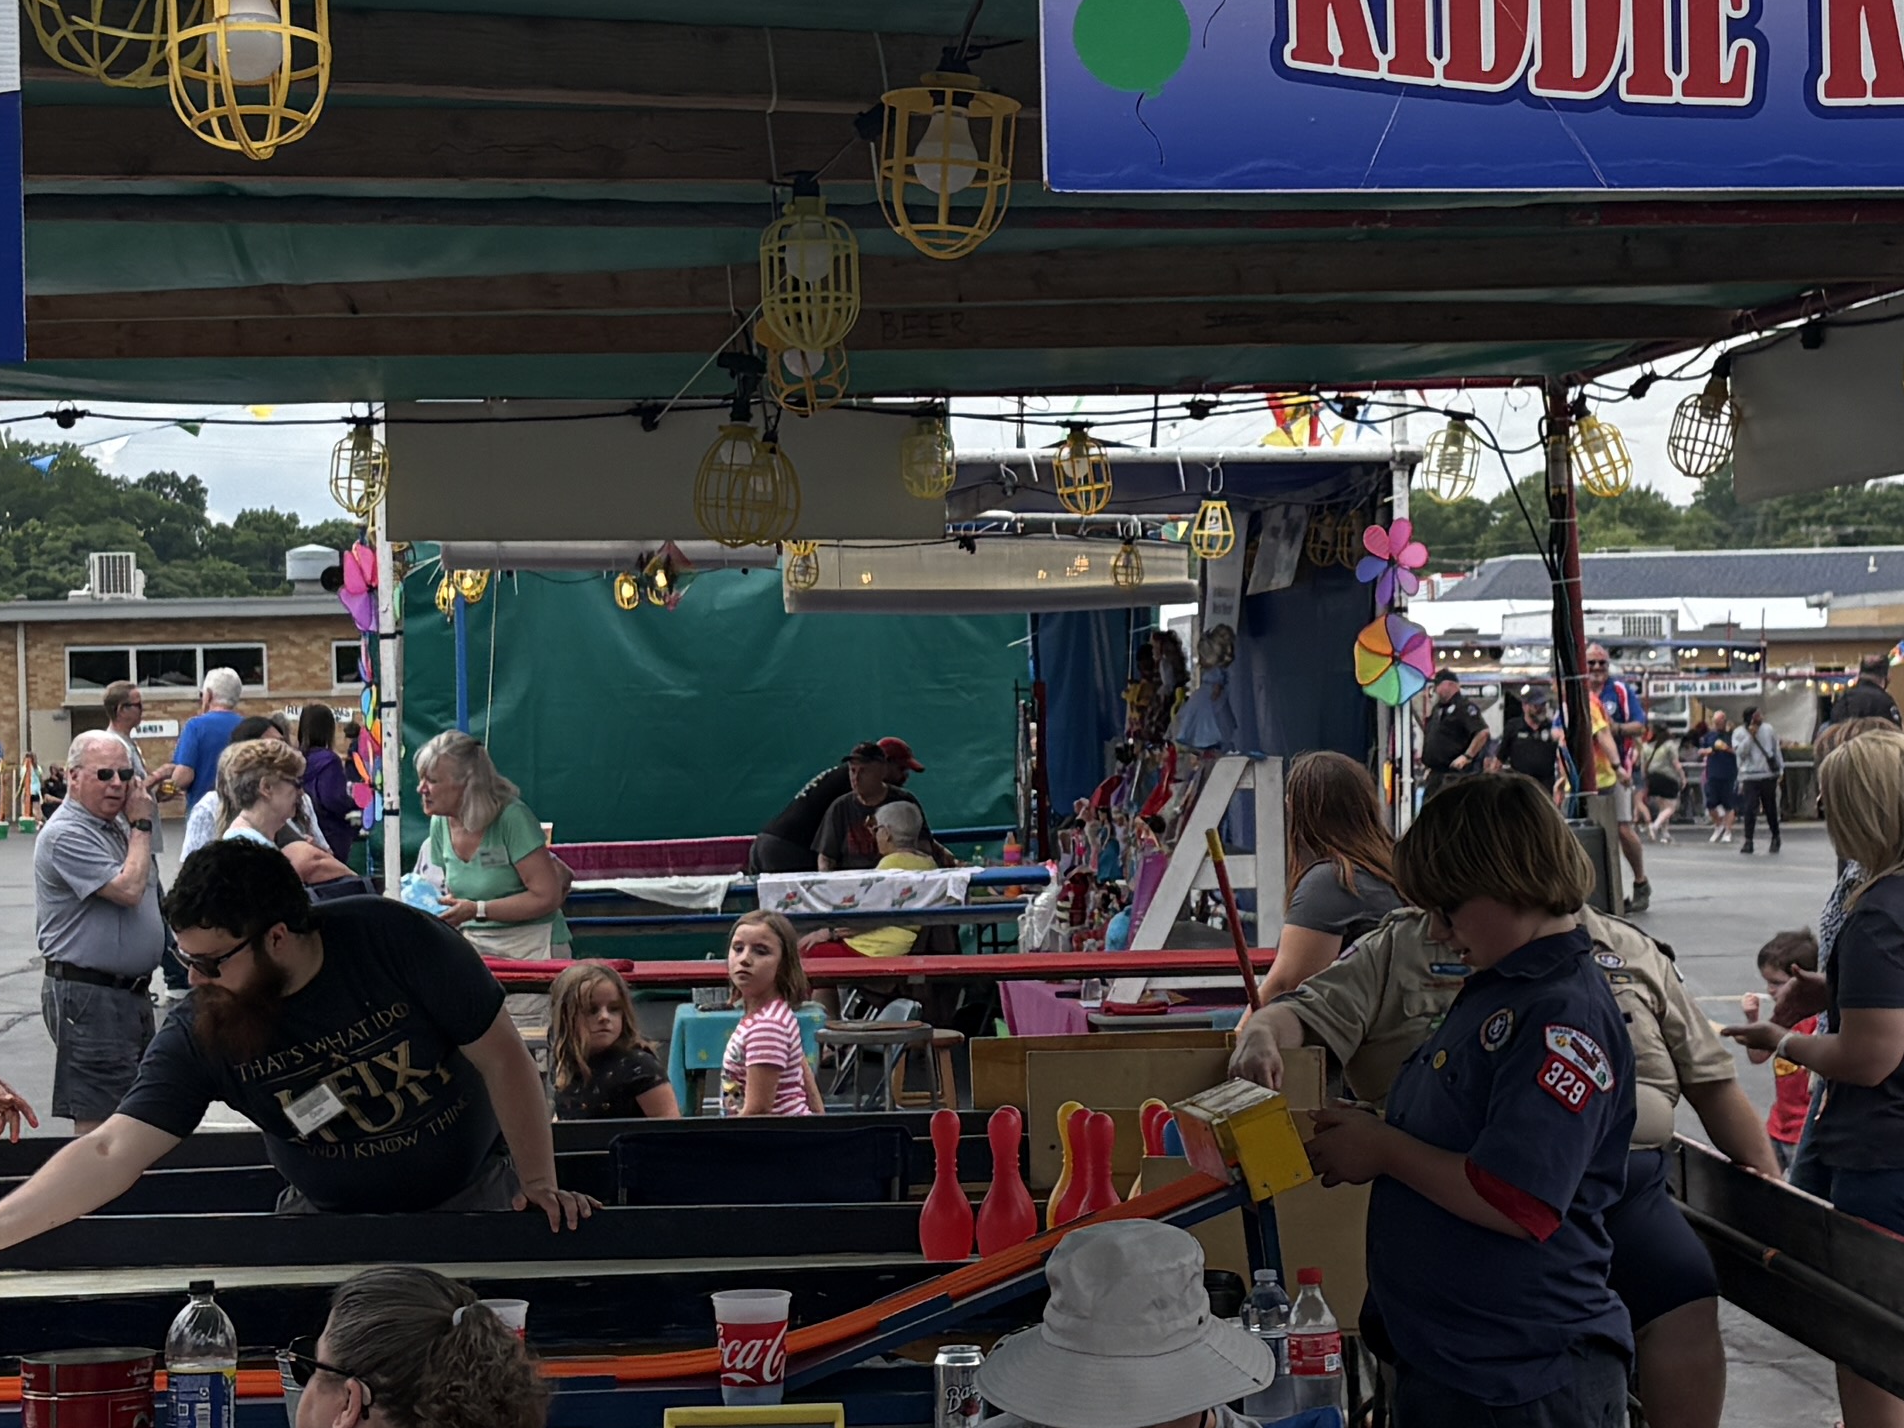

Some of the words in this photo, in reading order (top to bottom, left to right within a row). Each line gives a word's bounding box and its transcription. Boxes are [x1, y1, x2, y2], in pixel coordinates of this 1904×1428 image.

[235, 1045, 304, 1082] THAT'S
[304, 1018, 371, 1055] WHAT
[317, 1039, 433, 1099] FIX
[1544, 1061, 1587, 1105] 329
[354, 1128, 420, 1159] KNOW
[425, 1099, 468, 1137] THIN
